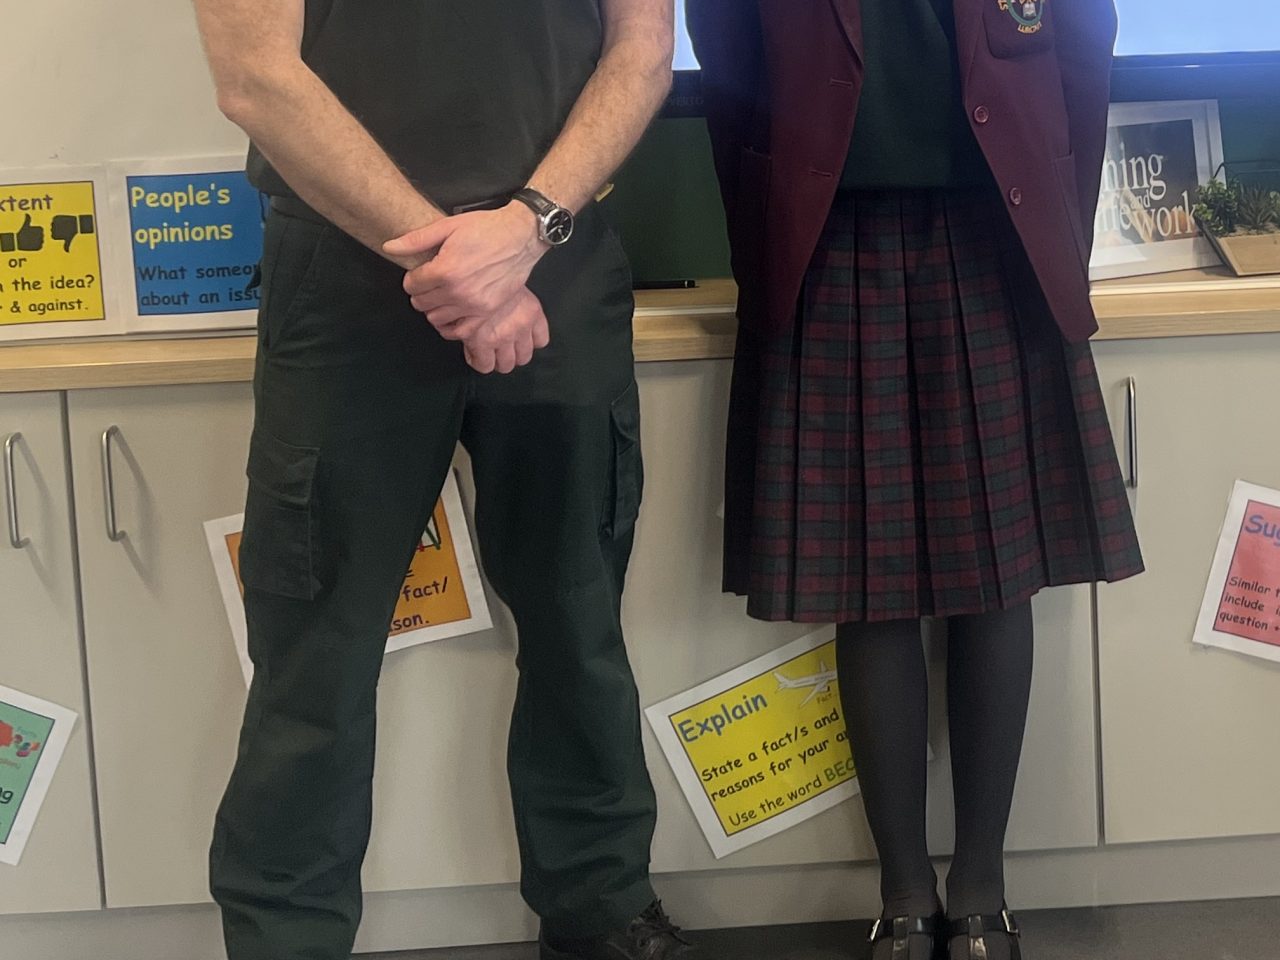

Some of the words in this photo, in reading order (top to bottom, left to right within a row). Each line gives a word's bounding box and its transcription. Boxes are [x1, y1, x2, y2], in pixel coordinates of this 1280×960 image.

[130, 184, 231, 213] People's
[1132, 190, 1196, 239] work
[134, 222, 233, 249] opinions
[8, 257, 27, 269] or
[138, 265, 187, 282] What
[12, 277, 42, 291] the
[50, 274, 95, 289] idea?
[10, 301, 21, 313] &
[28, 299, 88, 315] against.
[141, 290, 189, 306] about
[199, 292, 220, 304] an
[403, 576, 448, 602] fact/
[1228, 576, 1271, 595] Similar
[1224, 592, 1265, 612] include
[1219, 610, 1269, 631] question
[677, 692, 768, 744] Explain
[702, 757, 743, 782] State
[748, 752, 758, 762] a
[762, 726, 809, 756] fact/s
[814, 708, 839, 731] and
[711, 772, 765, 802] reasons
[769, 757, 792, 777] for
[799, 738, 830, 765] your
[729, 809, 757, 827] Use
[759, 796, 785, 815] the
[787, 776, 823, 801] word
